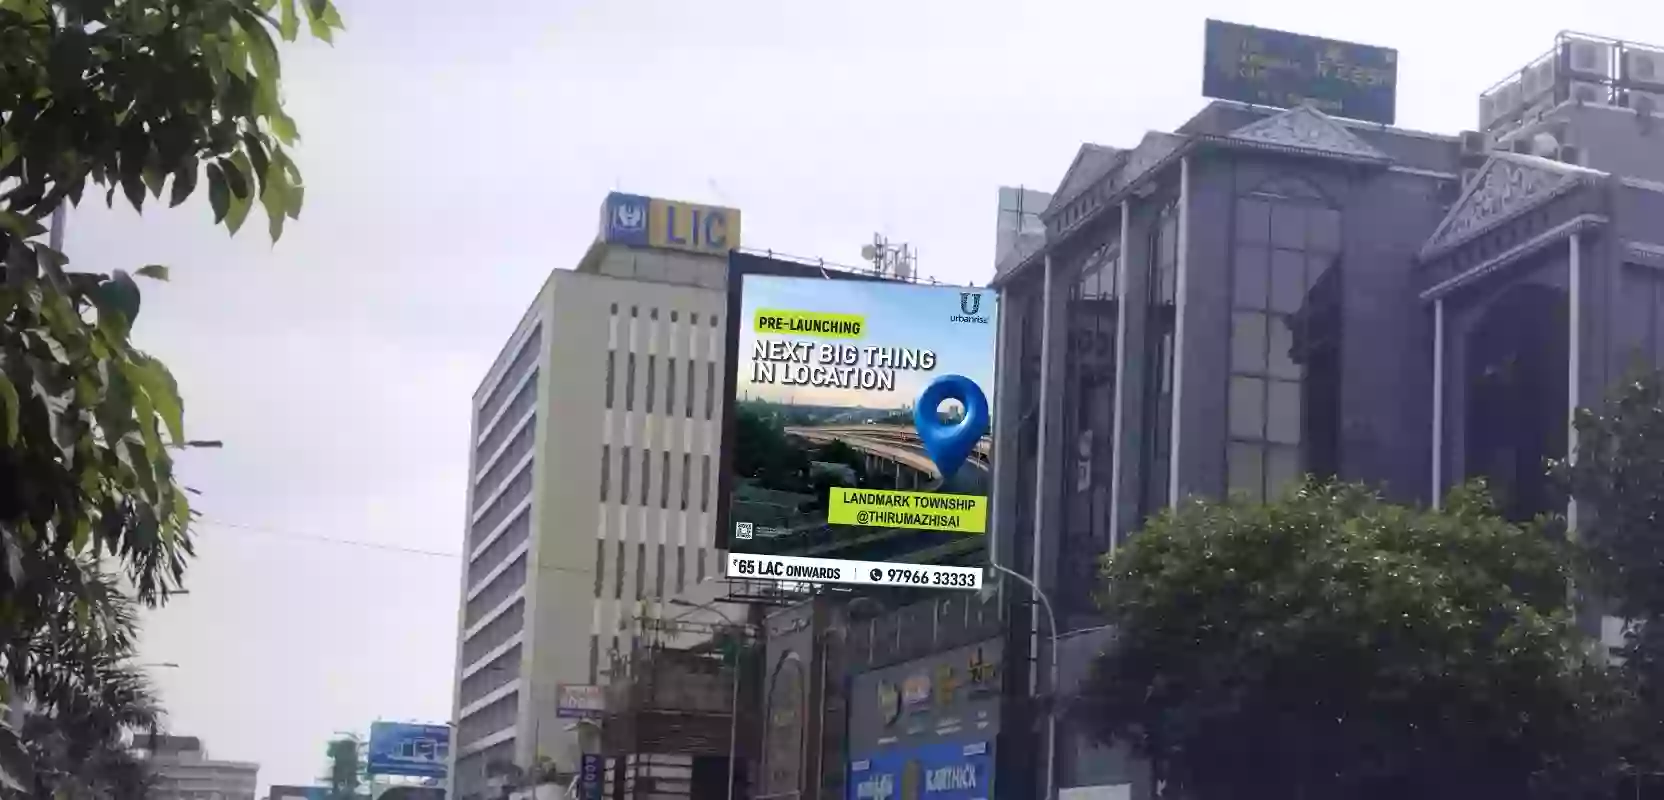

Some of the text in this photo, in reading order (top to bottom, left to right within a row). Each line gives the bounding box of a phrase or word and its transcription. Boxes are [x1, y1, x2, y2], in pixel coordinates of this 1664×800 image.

[667, 206, 727, 247] LIC
[759, 316, 861, 335] PRE-LAUNCHING
[752, 340, 936, 371] NEXT BIG THING
[751, 361, 896, 390] IN LOCATION
[843, 492, 976, 511] LANDMARK TOWNSHIP
[857, 510, 960, 528] @THIRUMAZHISAI
[758, 562, 783, 576] LAC
[785, 565, 841, 580] ONWARDS
[888, 569, 929, 585] 97966
[932, 572, 976, 587] 33333
